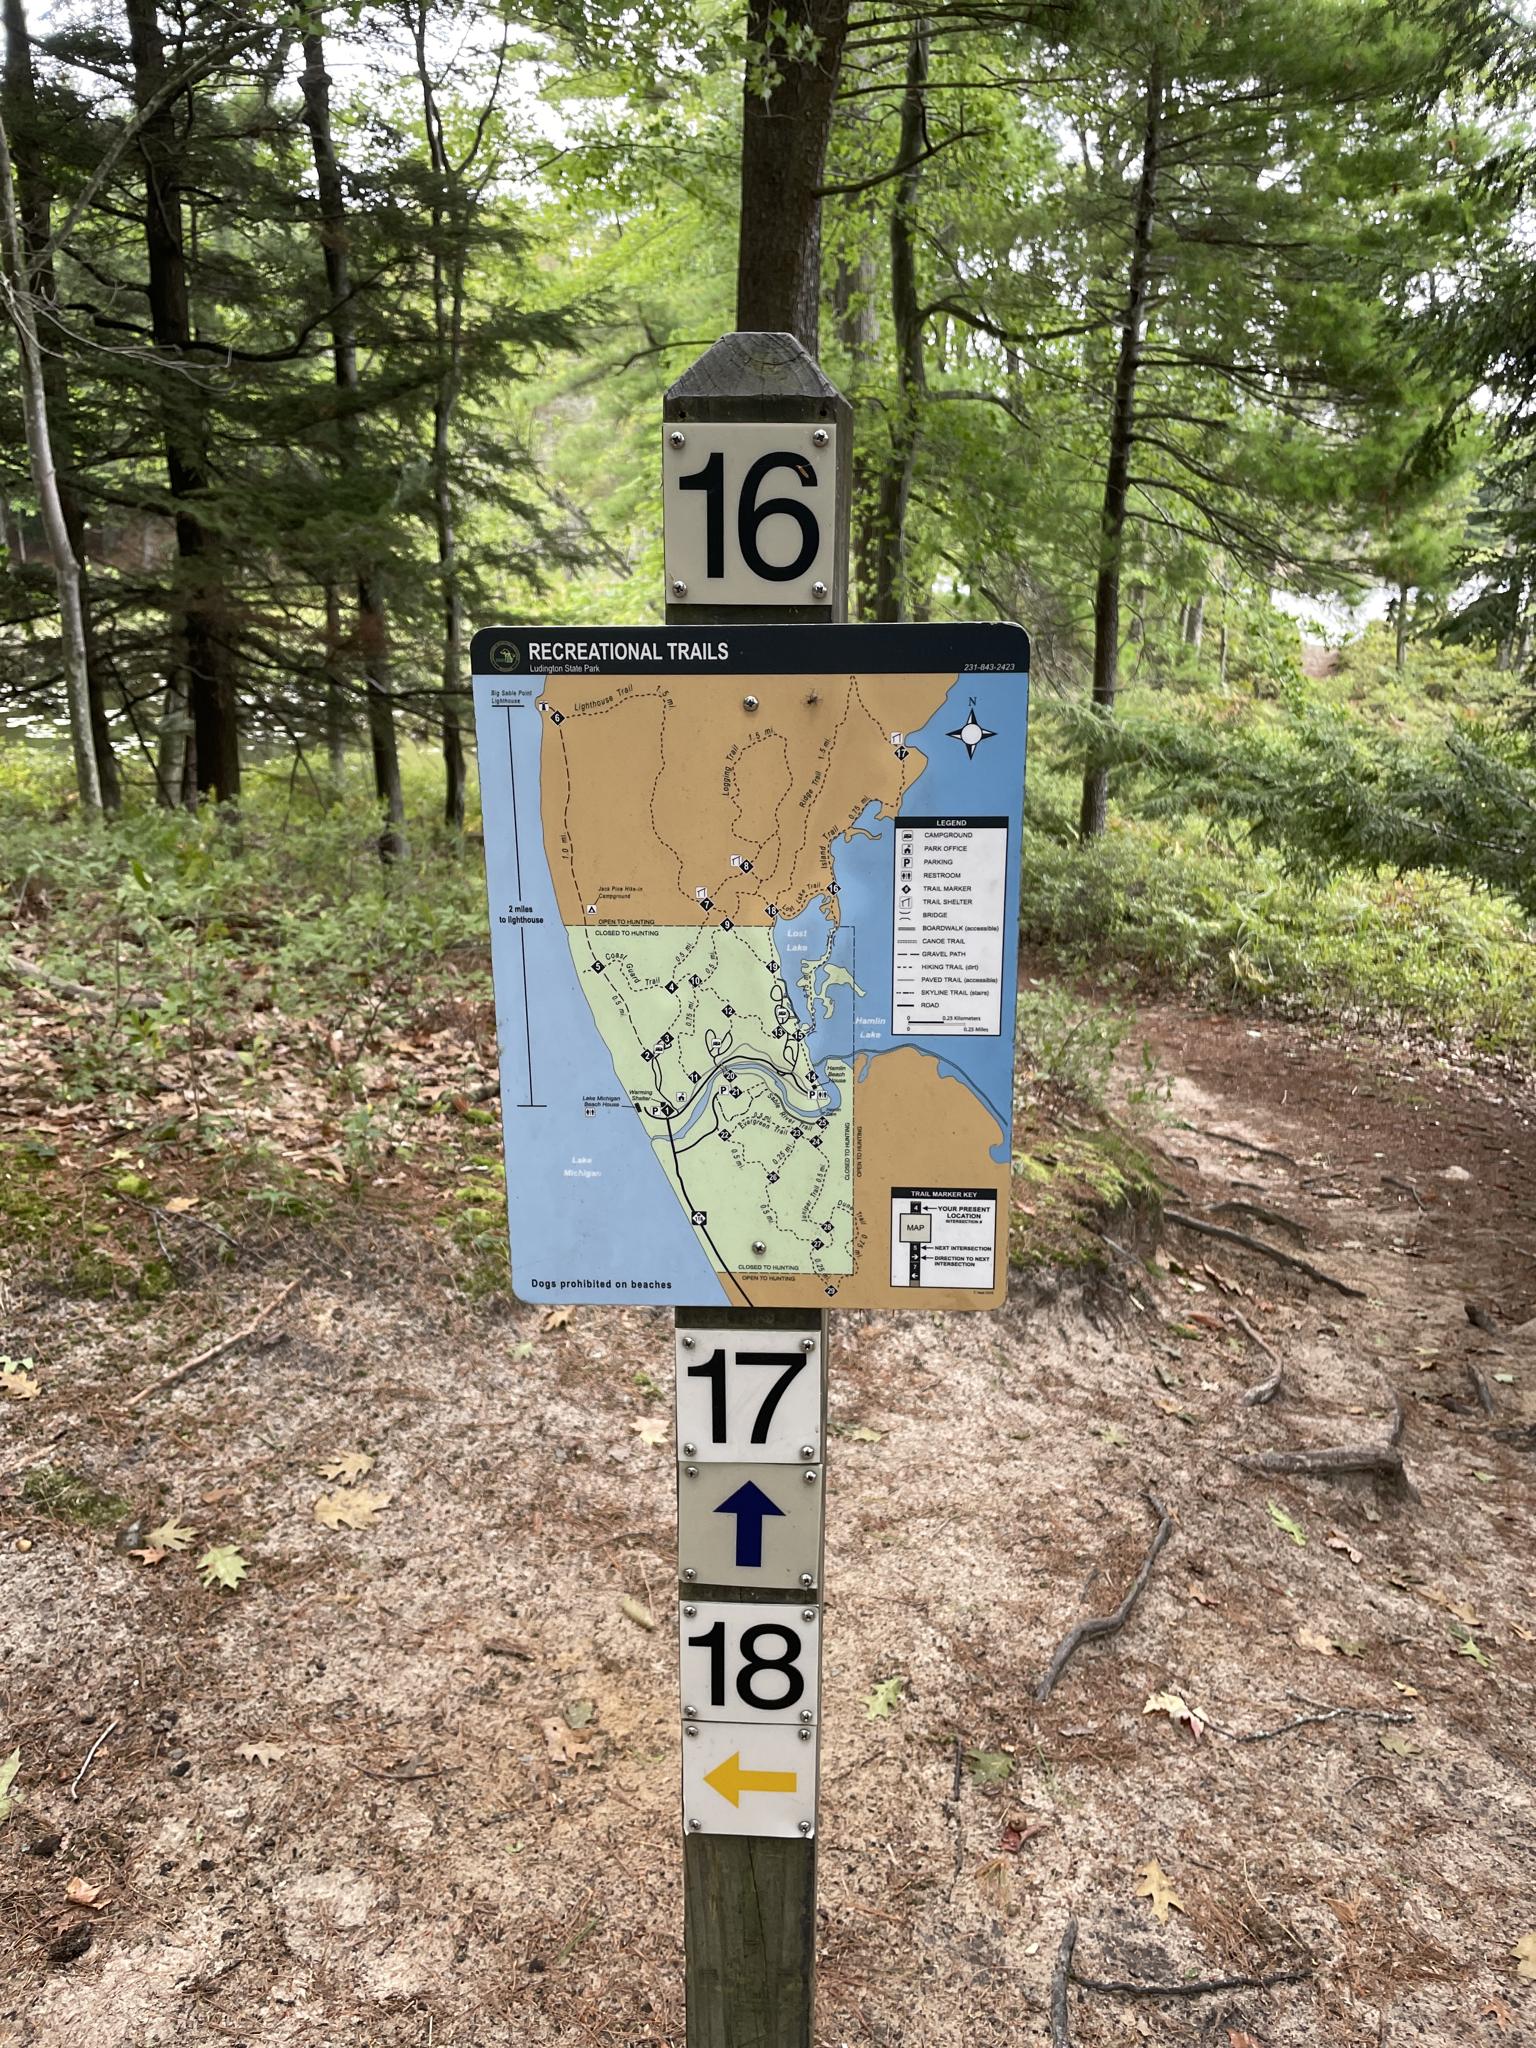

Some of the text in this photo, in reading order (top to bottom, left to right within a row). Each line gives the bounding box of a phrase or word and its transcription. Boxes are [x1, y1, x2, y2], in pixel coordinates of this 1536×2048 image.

[679, 451, 820, 582] 16
[529, 642, 729, 661] RECREATIONAL TRAILS
[530, 664, 600, 674] Ludington State Park
[964, 663, 1016, 671] 231-843-2423
[501, 689, 517, 697] Sable
[491, 697, 521, 705] Lighthouse
[574, 684, 633, 712] Lighthouse Trail
[968, 696, 977, 707] N
[555, 714, 560, 722] 6
[725, 744, 739, 762] Trail
[896, 748, 906, 758] 17
[722, 766, 733, 797] Logging
[811, 771, 822, 786] Trail
[799, 788, 814, 809] Ridge
[936, 819, 967, 827] LEGEND
[822, 824, 840, 841] Trail
[819, 845, 828, 869] Island
[744, 862, 749, 870] 8
[903, 858, 910, 867] P
[829, 885, 839, 893] 16
[508, 905, 533, 913] 2 miles
[705, 900, 709, 909] 7
[767, 906, 776, 914] 18
[499, 916, 544, 925] to lighthouse
[725, 920, 730, 929] 9
[787, 929, 808, 938] Lost
[786, 943, 808, 952] Lake
[595, 963, 601, 971] 5
[605, 952, 661, 986] Coast Guard Trail
[769, 963, 777, 971] 19
[691, 977, 700, 985] 10
[724, 1007, 733, 1015] 12
[855, 1017, 886, 1025] Hamlin
[645, 1052, 650, 1060] 2
[726, 1072, 735, 1080] 20
[808, 1073, 816, 1081] 14
[731, 1088, 740, 1096] 21
[739, 1117, 771, 1130] Evergreen
[818, 1118, 827, 1126] 25
[844, 1148, 850, 1156] TO
[563, 1169, 602, 1178] Michigan
[823, 1223, 832, 1231] 28
[531, 1278, 557, 1290] Dogs
[560, 1279, 612, 1290] prohibited
[631, 1279, 672, 1289] beaches
[687, 1349, 807, 1444] 17
[688, 1621, 805, 1710] 18
